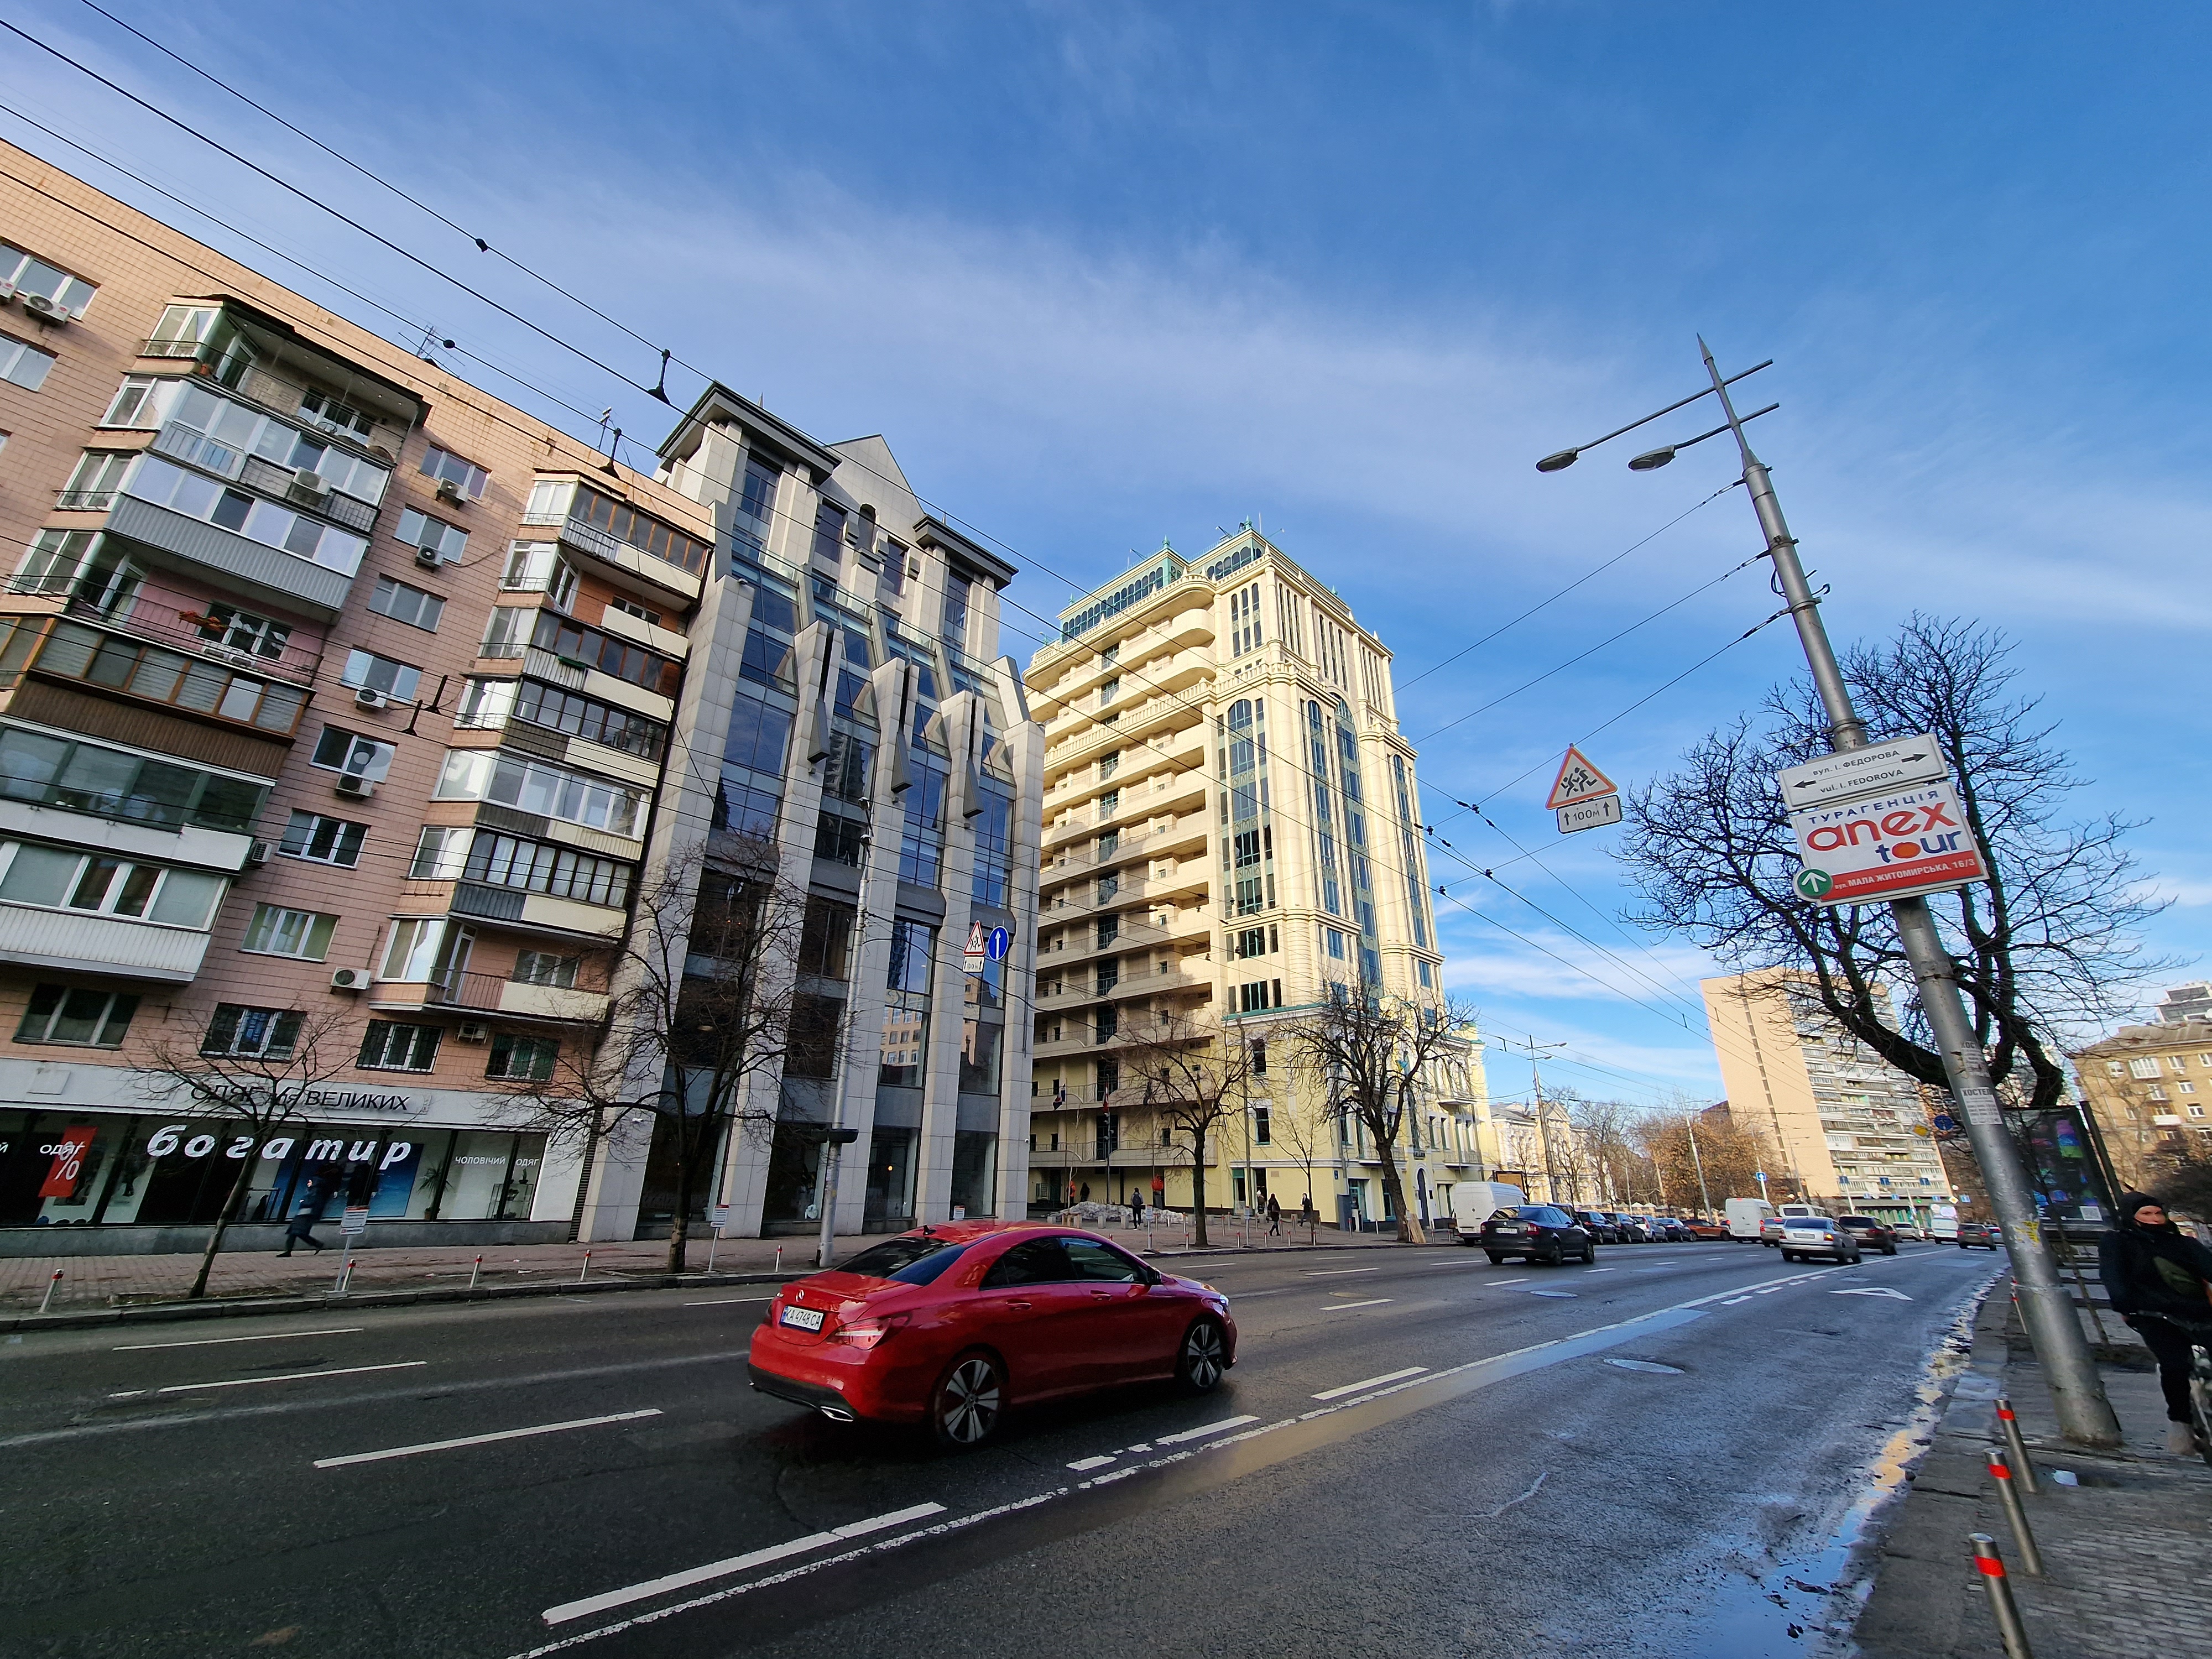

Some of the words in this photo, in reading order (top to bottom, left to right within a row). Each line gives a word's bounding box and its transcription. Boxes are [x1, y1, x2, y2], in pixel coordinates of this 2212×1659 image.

[1813, 768, 1833, 776] вул.
[1843, 750, 1900, 768] ФЕДОРОВА
[1820, 784, 1838, 793] vul.
[1848, 769, 1904, 787] FEDOROVA
[1808, 790, 1939, 825] ТУРАГЕНЦІЯ
[1806, 801, 1959, 851] anex
[1875, 831, 1961, 864] tour
[1848, 875, 1875, 887] МАЛА
[304, 1090, 410, 1111] ВЕЛИКИХ
